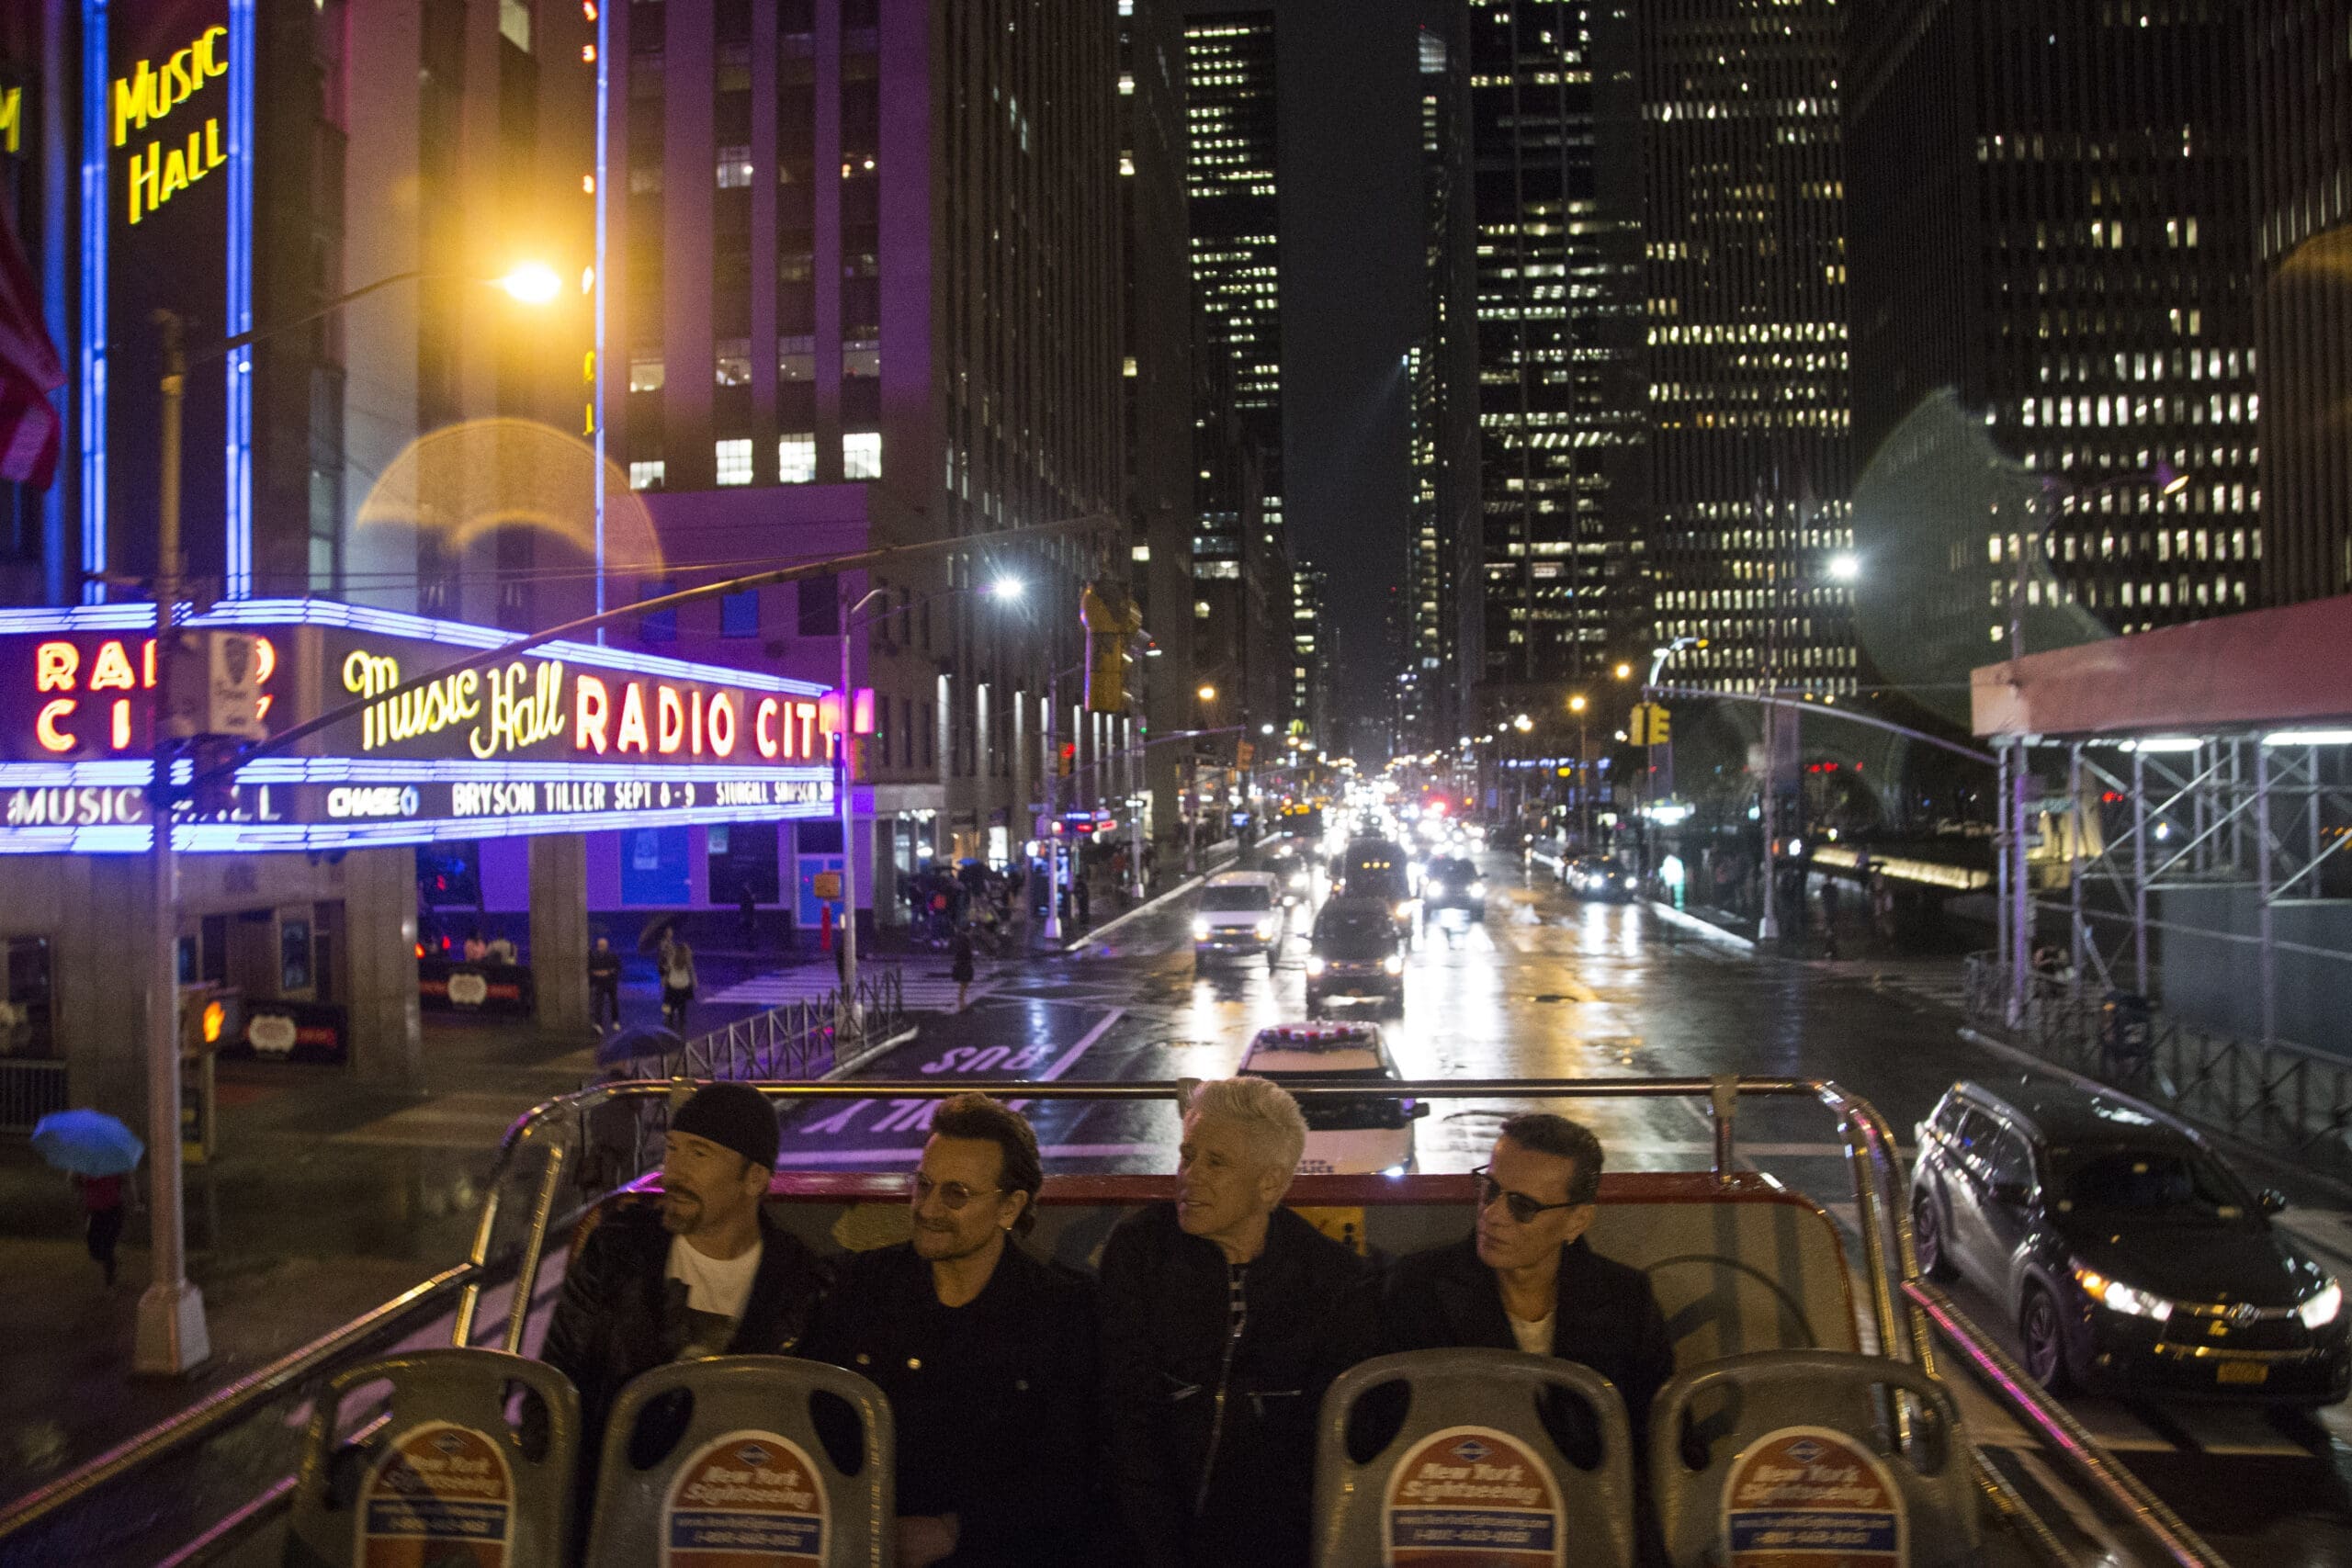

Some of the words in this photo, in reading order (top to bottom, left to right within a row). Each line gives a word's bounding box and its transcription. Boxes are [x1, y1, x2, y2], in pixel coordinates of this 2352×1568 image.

[114, 26, 229, 147] MUSIC
[129, 118, 228, 225] HALL
[343, 649, 481, 751] Music
[469, 660, 566, 760] Hall
[575, 673, 734, 756] RADIO
[451, 782, 536, 817] BRYSON
[543, 781, 606, 814] TILLER
[614, 781, 652, 810] SEPT
[920, 1040, 1057, 1074] BUS
